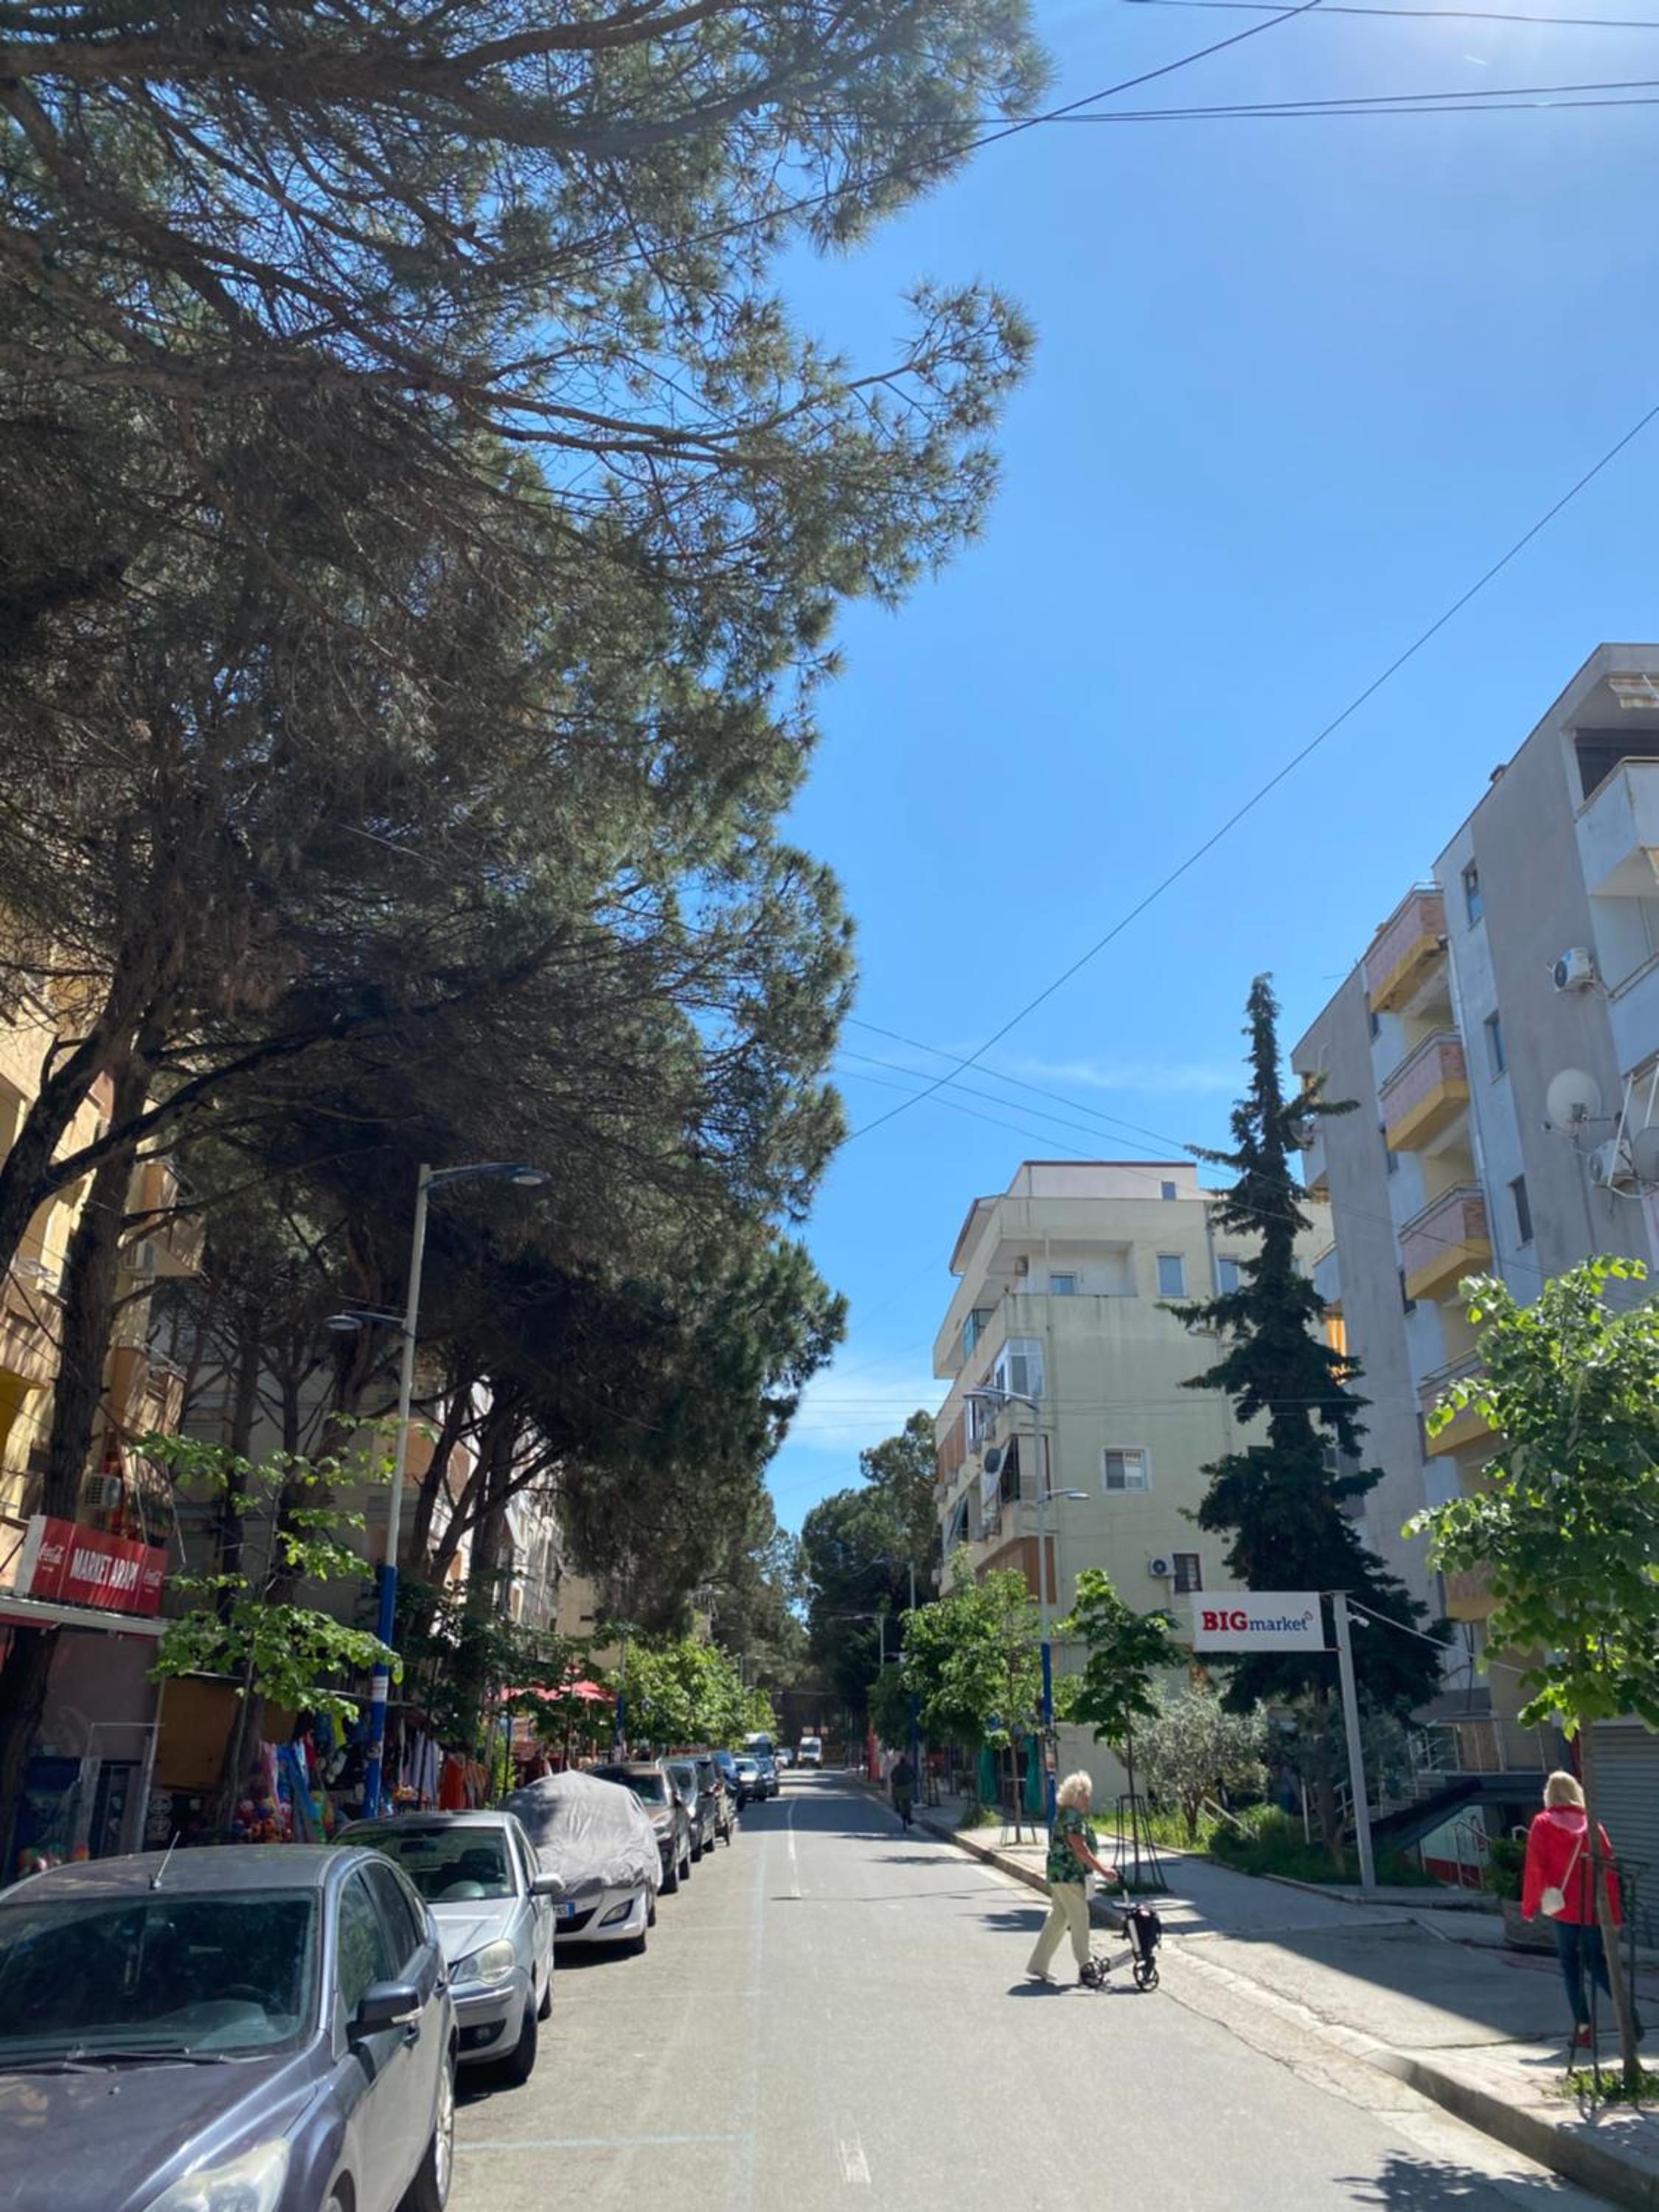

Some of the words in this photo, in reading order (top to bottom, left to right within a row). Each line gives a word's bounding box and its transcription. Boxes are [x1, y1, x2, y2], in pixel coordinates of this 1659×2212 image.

[70, 1548, 112, 1585] MARKET
[1202, 1611, 1248, 1631] BIG
[1249, 1616, 1308, 1631] market
